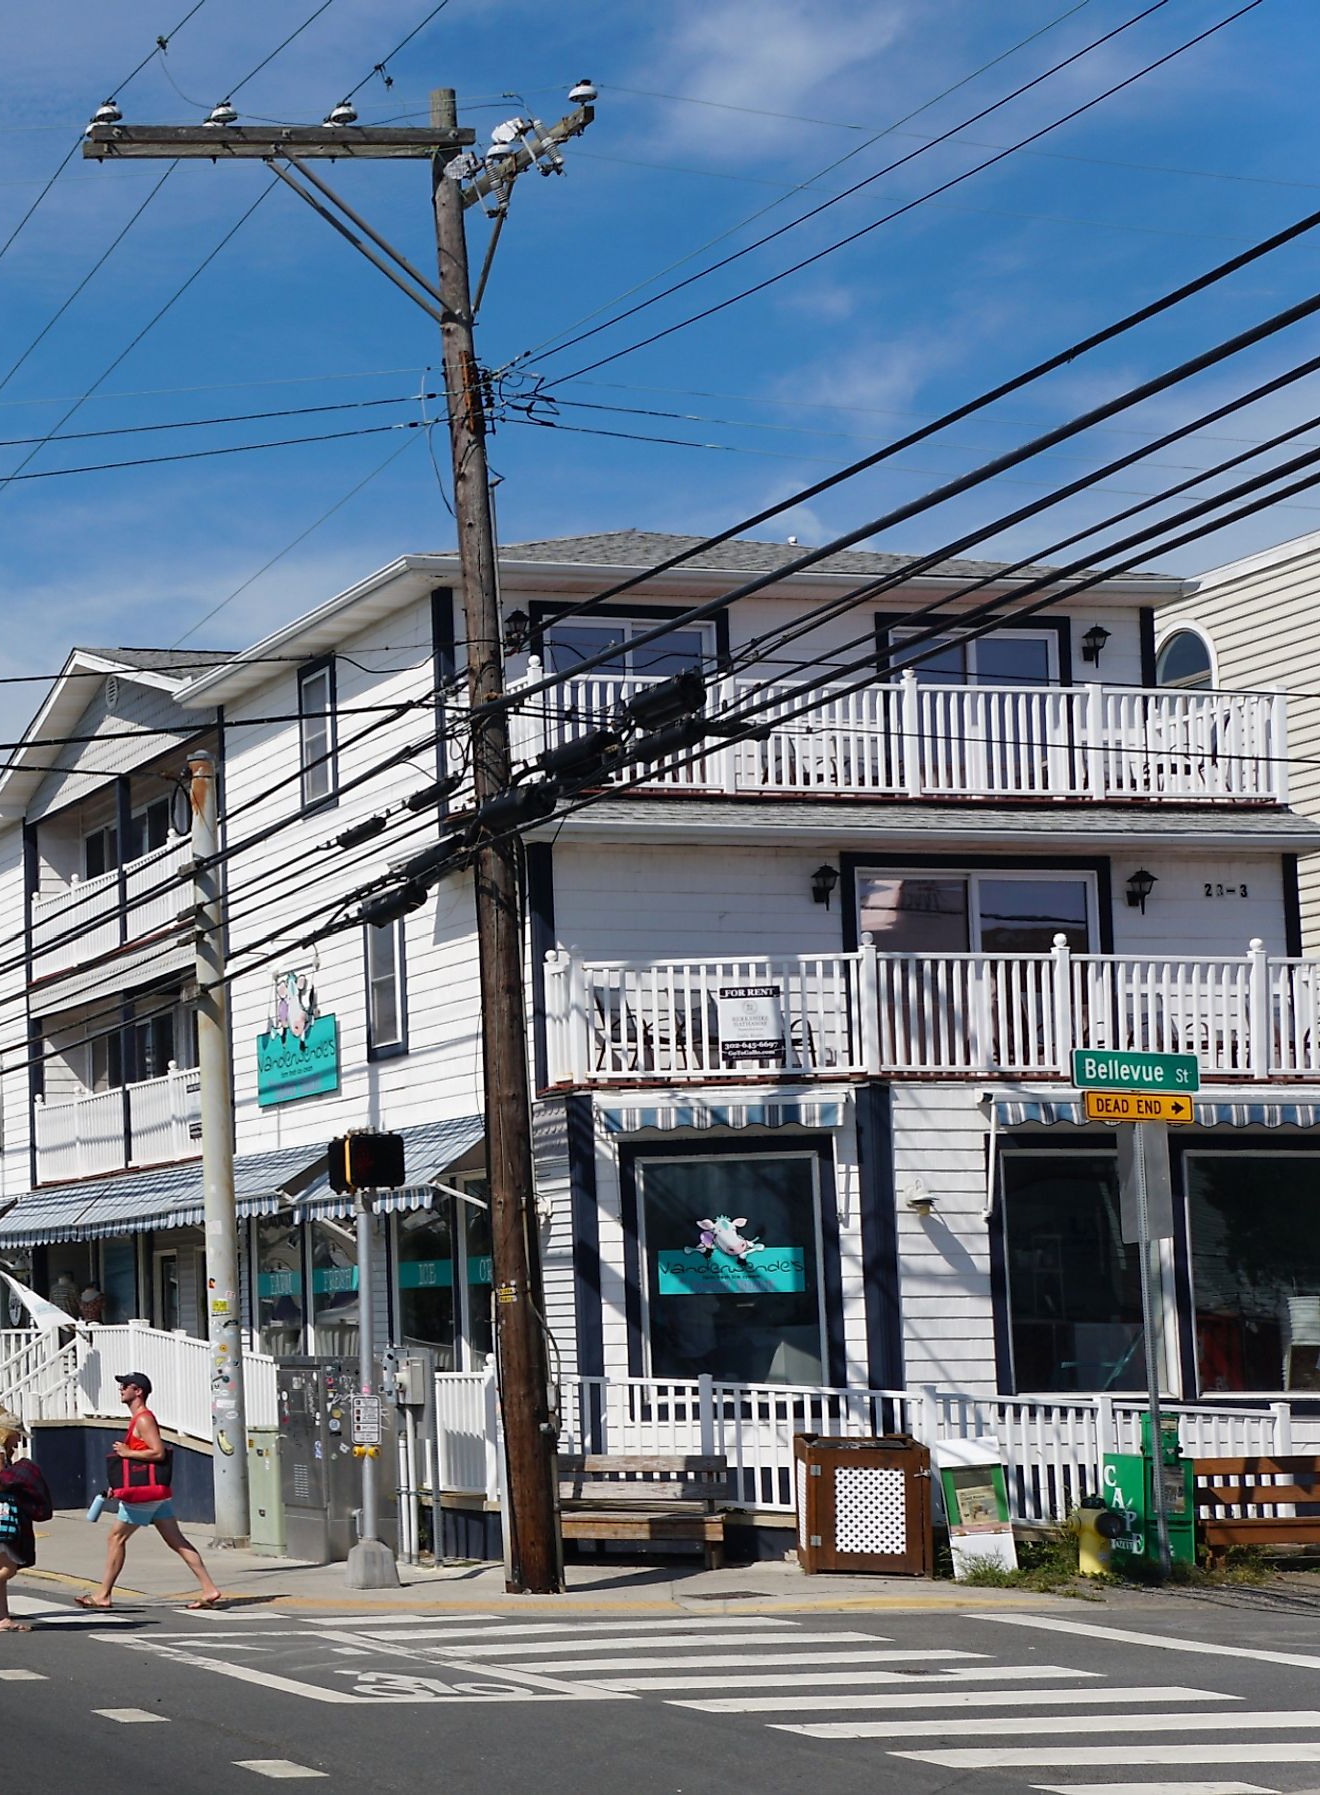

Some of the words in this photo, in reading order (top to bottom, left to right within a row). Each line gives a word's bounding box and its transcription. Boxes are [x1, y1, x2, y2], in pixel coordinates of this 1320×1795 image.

[724, 989, 746, 998] FOR
[747, 988, 773, 997] RENT
[724, 1041, 779, 1050] 302-645-6697
[1084, 1058, 1164, 1082] Bellevue
[1175, 1068, 1189, 1083] St
[1096, 1098, 1129, 1113] DEAD
[1137, 1099, 1162, 1115] END
[418, 1263, 436, 1285] ICE
[660, 1260, 805, 1275] Vanderwende's
